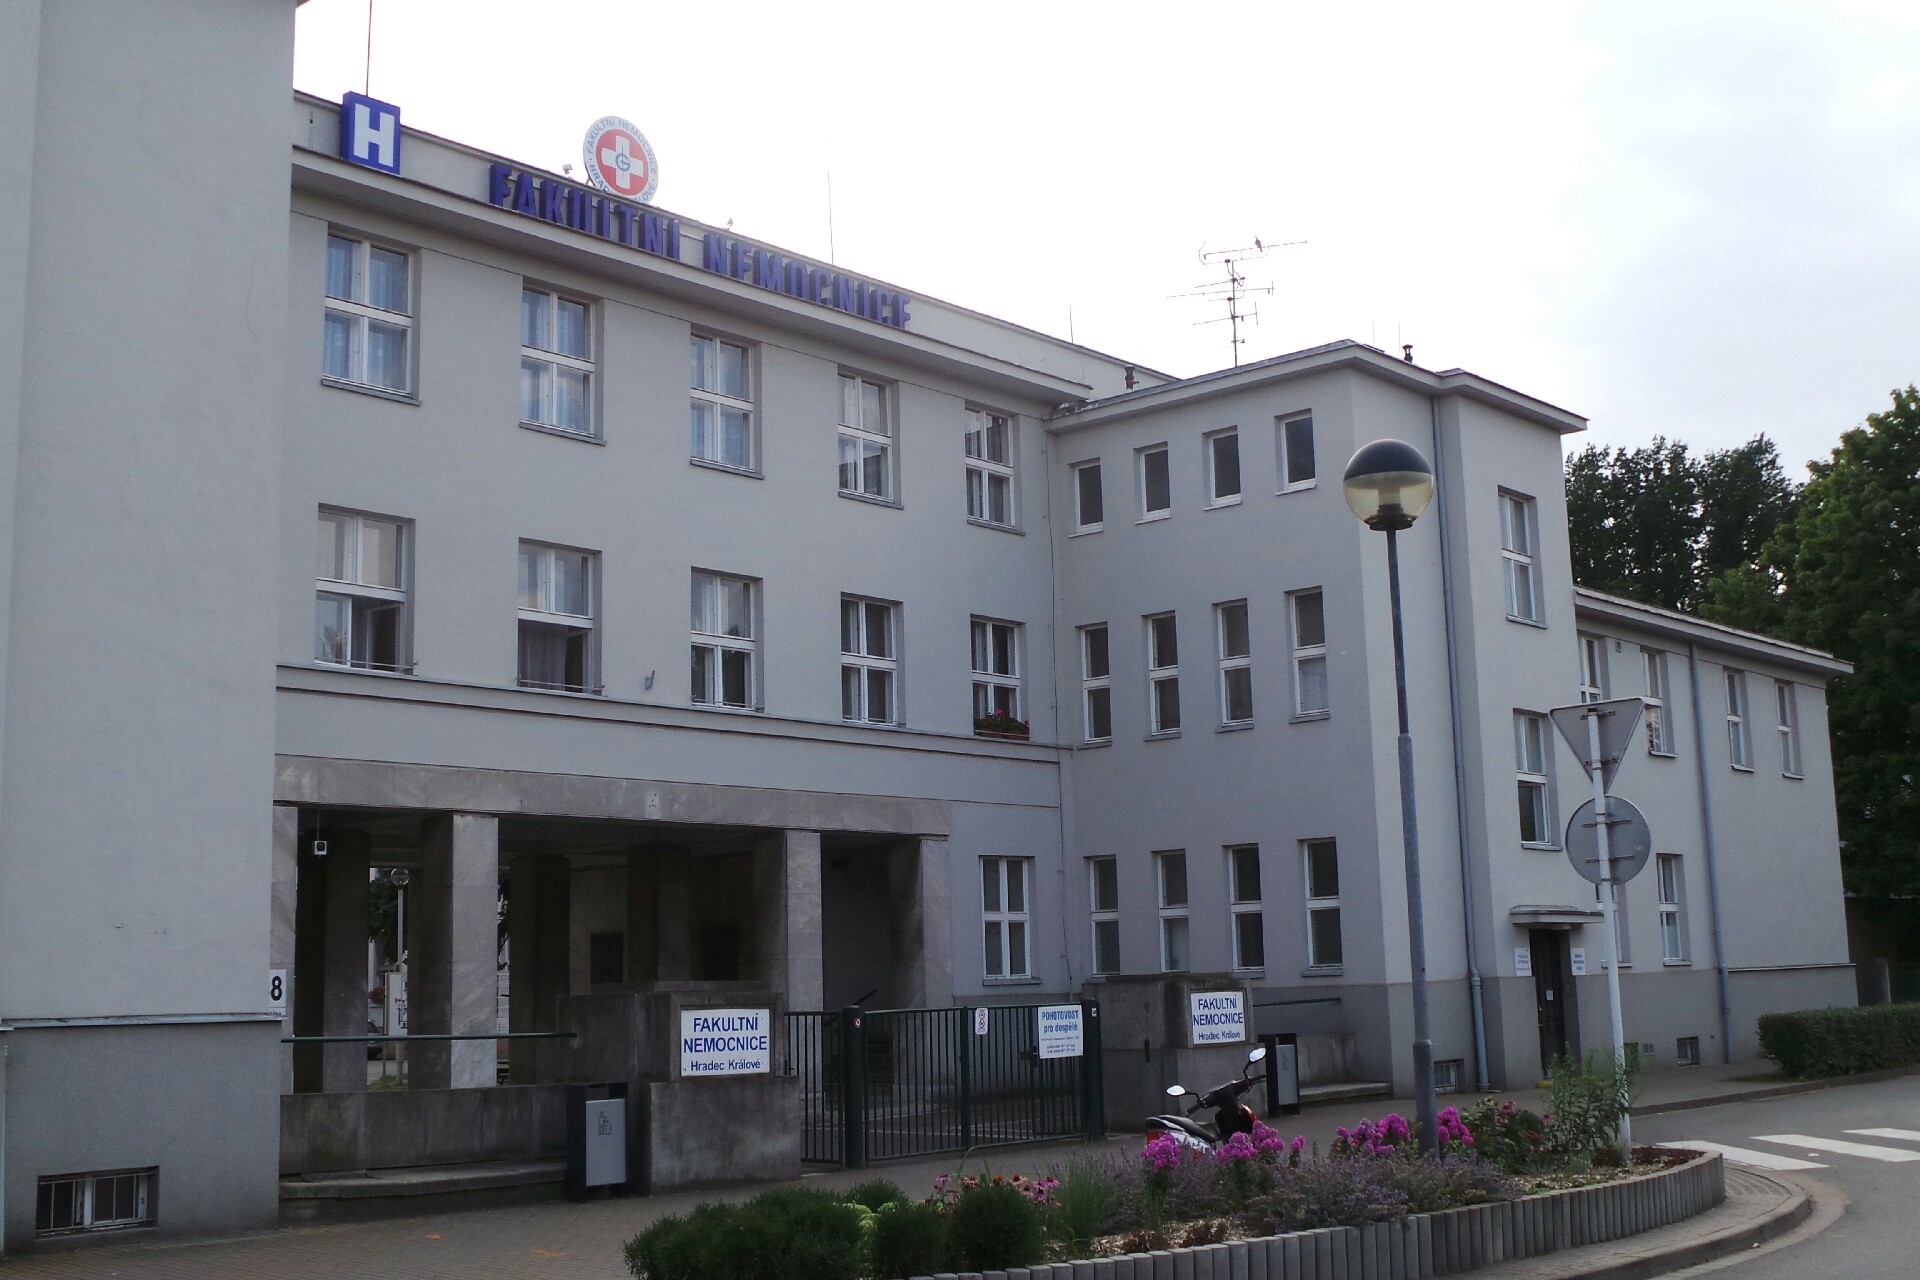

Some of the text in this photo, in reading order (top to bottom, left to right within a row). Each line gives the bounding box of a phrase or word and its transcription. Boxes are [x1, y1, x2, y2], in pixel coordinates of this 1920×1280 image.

[353, 103, 395, 168] H
[618, 119, 657, 175] NEMOCNICE
[270, 975, 283, 1002] 8
[1198, 994, 1237, 1010] FAKULTNÍ
[693, 1012, 759, 1032] FAKULTNÍ
[1042, 1010, 1079, 1020] POHOTOVOST
[1193, 1012, 1243, 1026] NEMOCNICE
[1043, 1024, 1053, 1034] pro
[1198, 1030, 1242, 1040] Hradec Králové
[683, 1035, 768, 1053] NEMOCNICE
[690, 1058, 761, 1072] Hradec Králové
